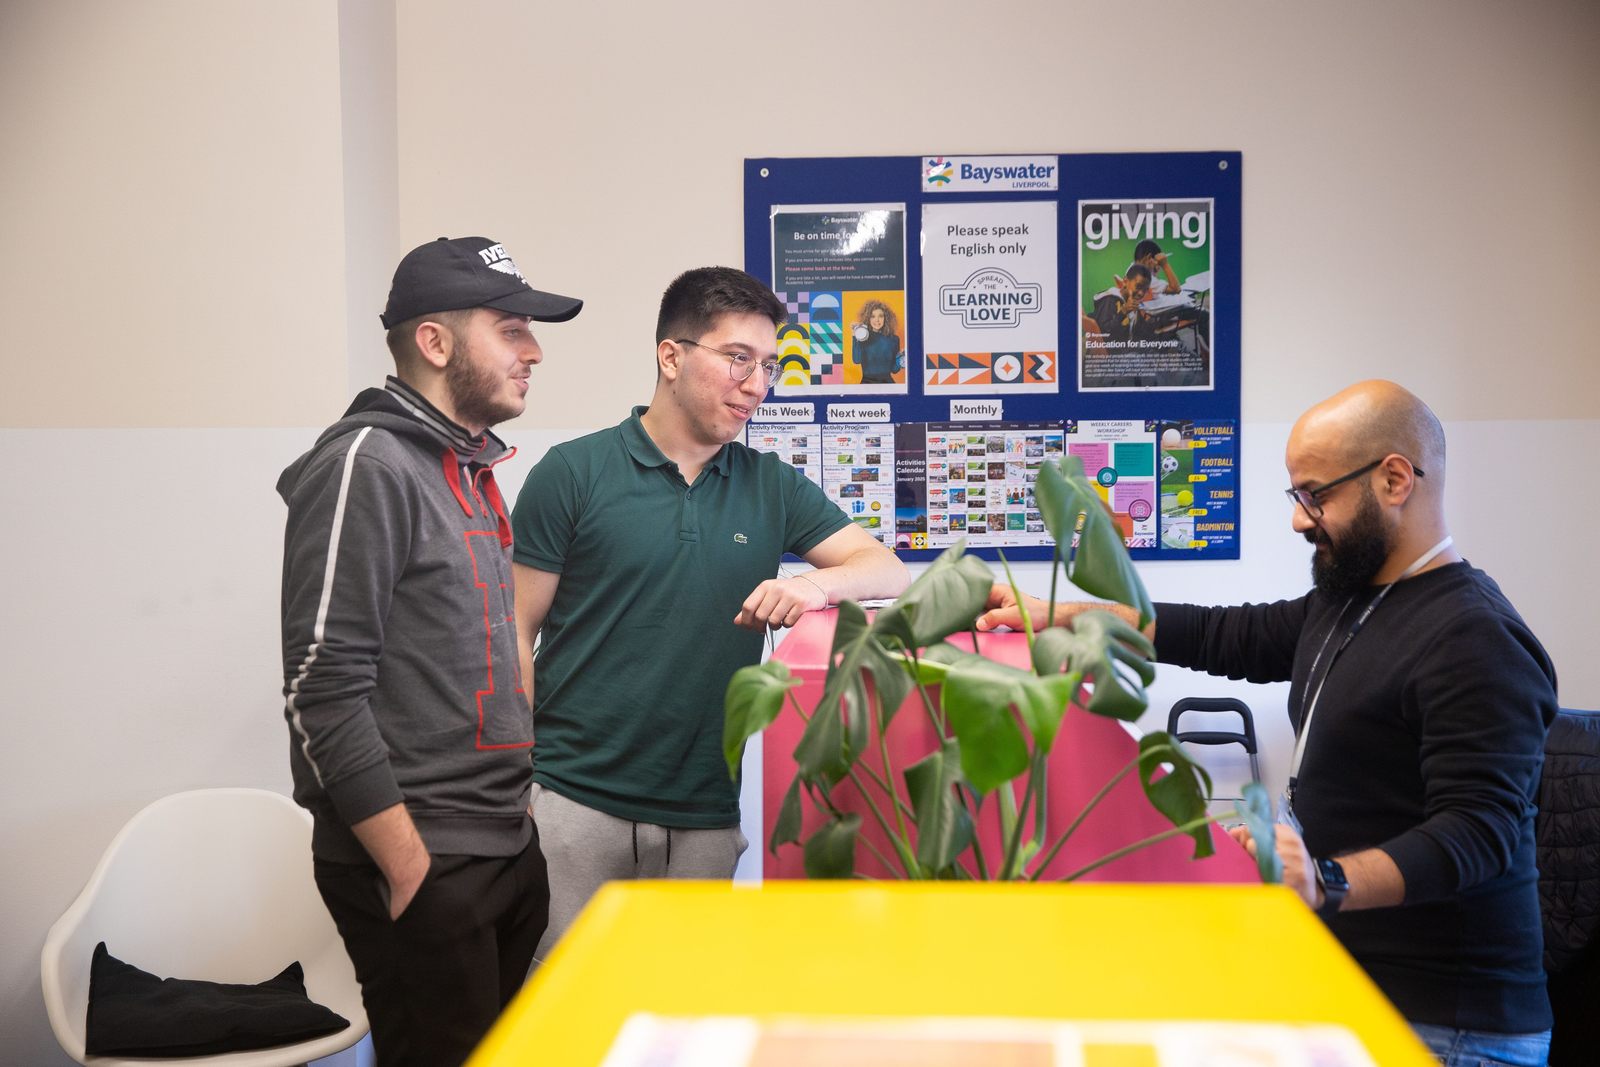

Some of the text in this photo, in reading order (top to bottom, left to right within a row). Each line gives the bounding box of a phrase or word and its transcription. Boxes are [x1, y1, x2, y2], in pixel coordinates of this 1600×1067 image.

[961, 163, 1055, 183] Bayswater
[1012, 181, 1050, 189] LIVERPOOL
[947, 223, 1029, 238] Please speak
[1084, 203, 1206, 250] giving
[794, 232, 805, 240] Be
[820, 231, 840, 240] time
[951, 242, 1027, 257] English only
[977, 275, 1004, 285] SPREAD
[949, 292, 1033, 307] LEARNING
[970, 308, 1010, 321] LOVE
[1085, 339, 1178, 350] Education for Everyone
[756, 407, 810, 416] This Week
[830, 408, 886, 418] Next week
[954, 405, 997, 416] Monthly
[1193, 426, 1234, 435] VOLLEYBALL
[1200, 458, 1234, 467] FOOTBALL
[1210, 490, 1234, 499] TENNIS
[1196, 523, 1235, 532] BADMINTON
